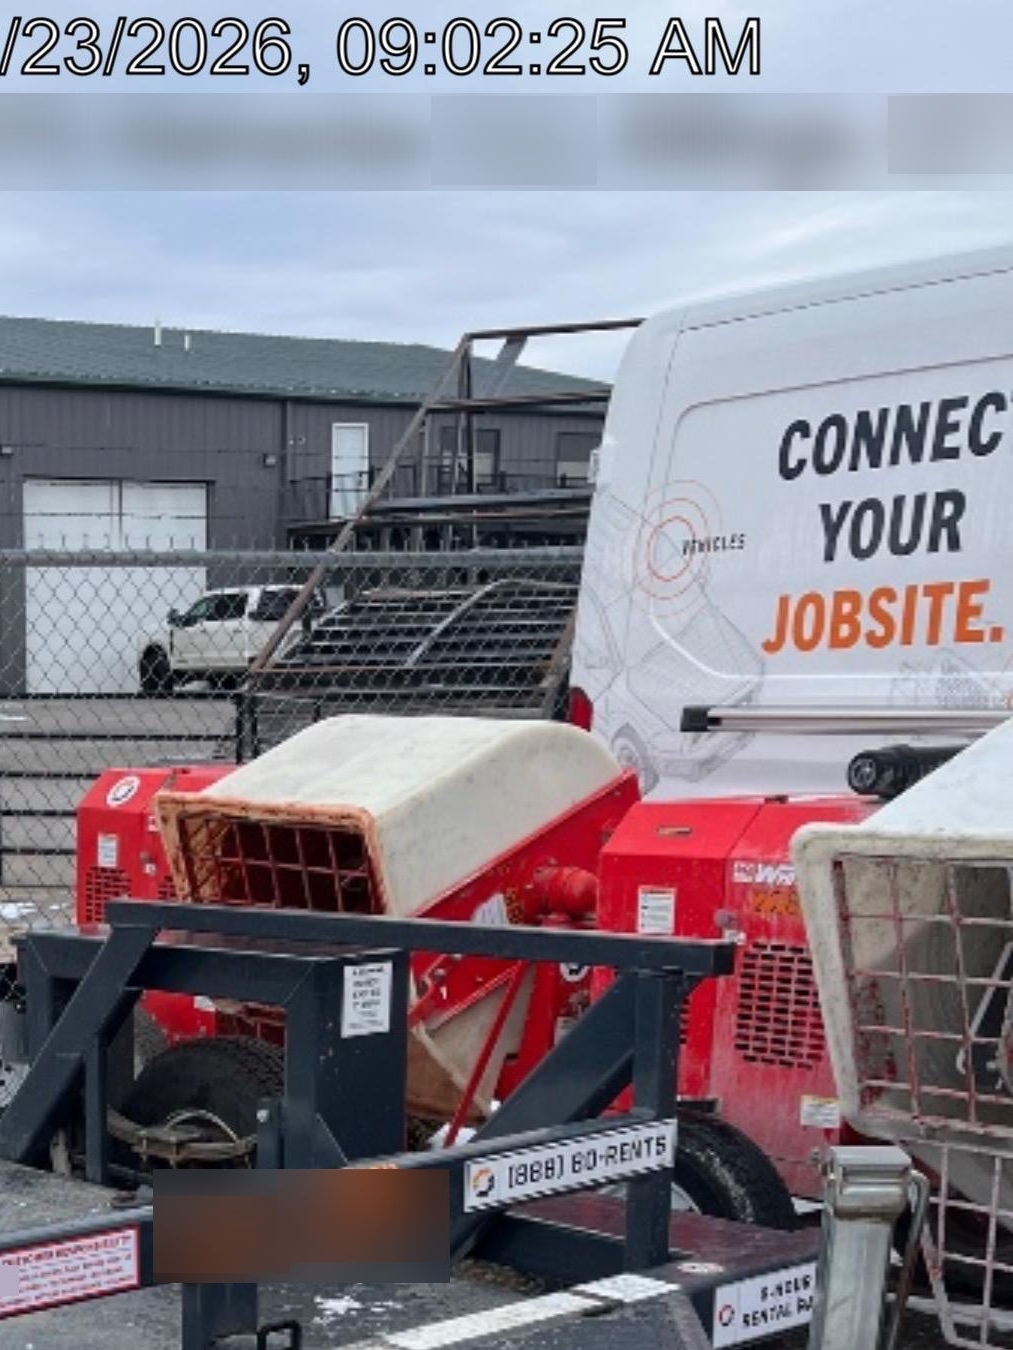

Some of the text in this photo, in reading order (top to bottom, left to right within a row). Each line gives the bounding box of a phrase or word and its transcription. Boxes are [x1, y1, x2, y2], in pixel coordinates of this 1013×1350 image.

[778, 390, 1013, 481] CONNEC
[819, 488, 967, 563] YOUR
[761, 578, 1004, 655] JOBSITE.
